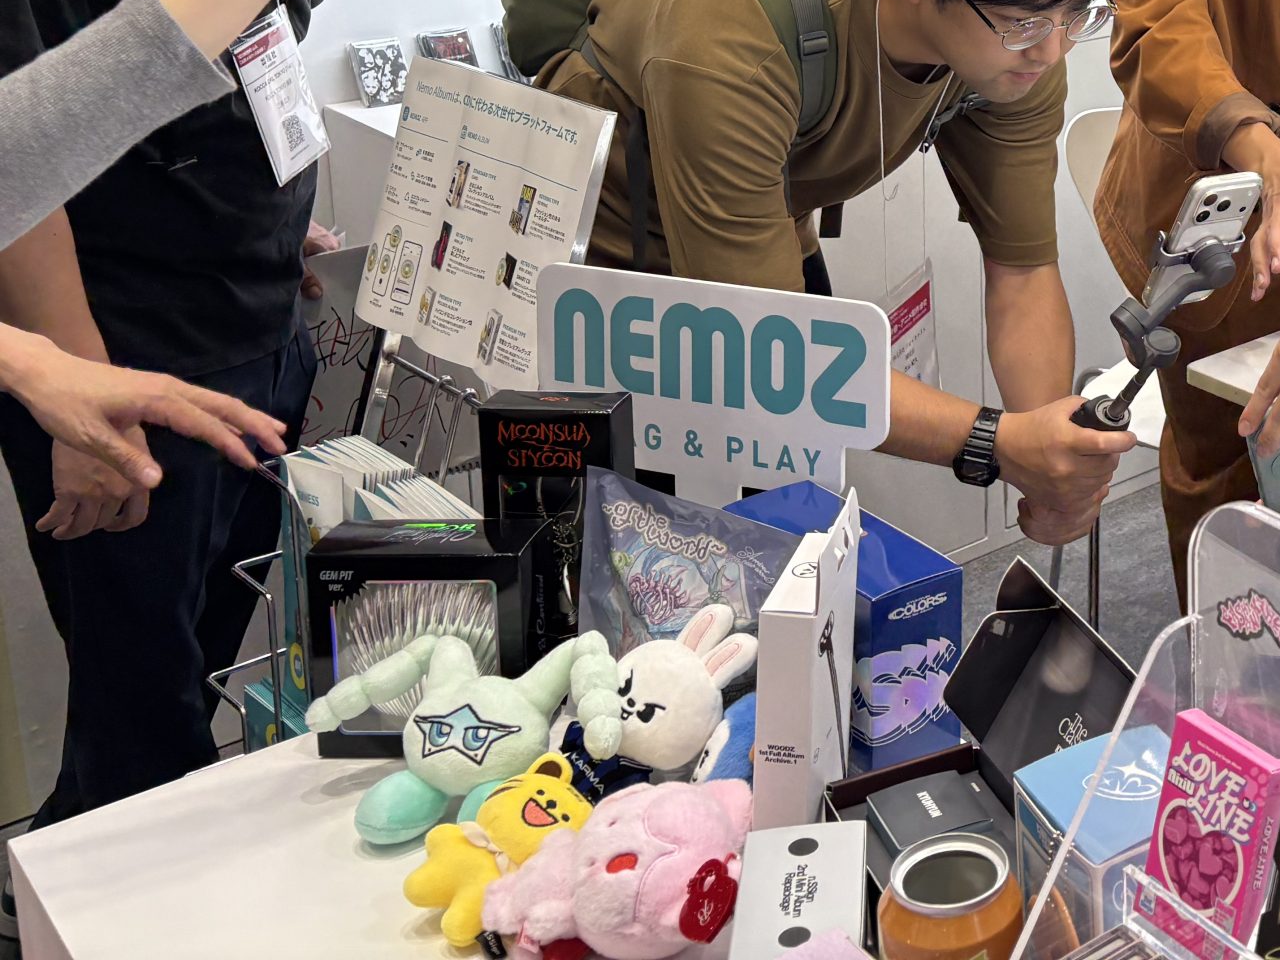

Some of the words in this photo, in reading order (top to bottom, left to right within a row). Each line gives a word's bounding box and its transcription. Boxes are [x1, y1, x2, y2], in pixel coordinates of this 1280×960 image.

[416, 80, 434, 96] Nemo
[684, 429, 704, 458] &
[726, 439, 822, 476] PLAY
[319, 570, 338, 580] GEM
[338, 570, 354, 580] PIT
[328, 582, 344, 592] ver.
[888, 592, 948, 620] COLORS
[758, 749, 769, 757] 1st
[768, 751, 782, 759] Full
[782, 751, 805, 760] Album
[767, 743, 796, 753] WOODZ
[764, 756, 793, 765] Archive.
[570, 751, 605, 795] KARMA
[1171, 739, 1247, 806] LOVE
[1186, 783, 1255, 845] LINE
[796, 864, 808, 878] 2nd
[778, 872, 796, 912] Repackage
[792, 895, 804, 918] Album
